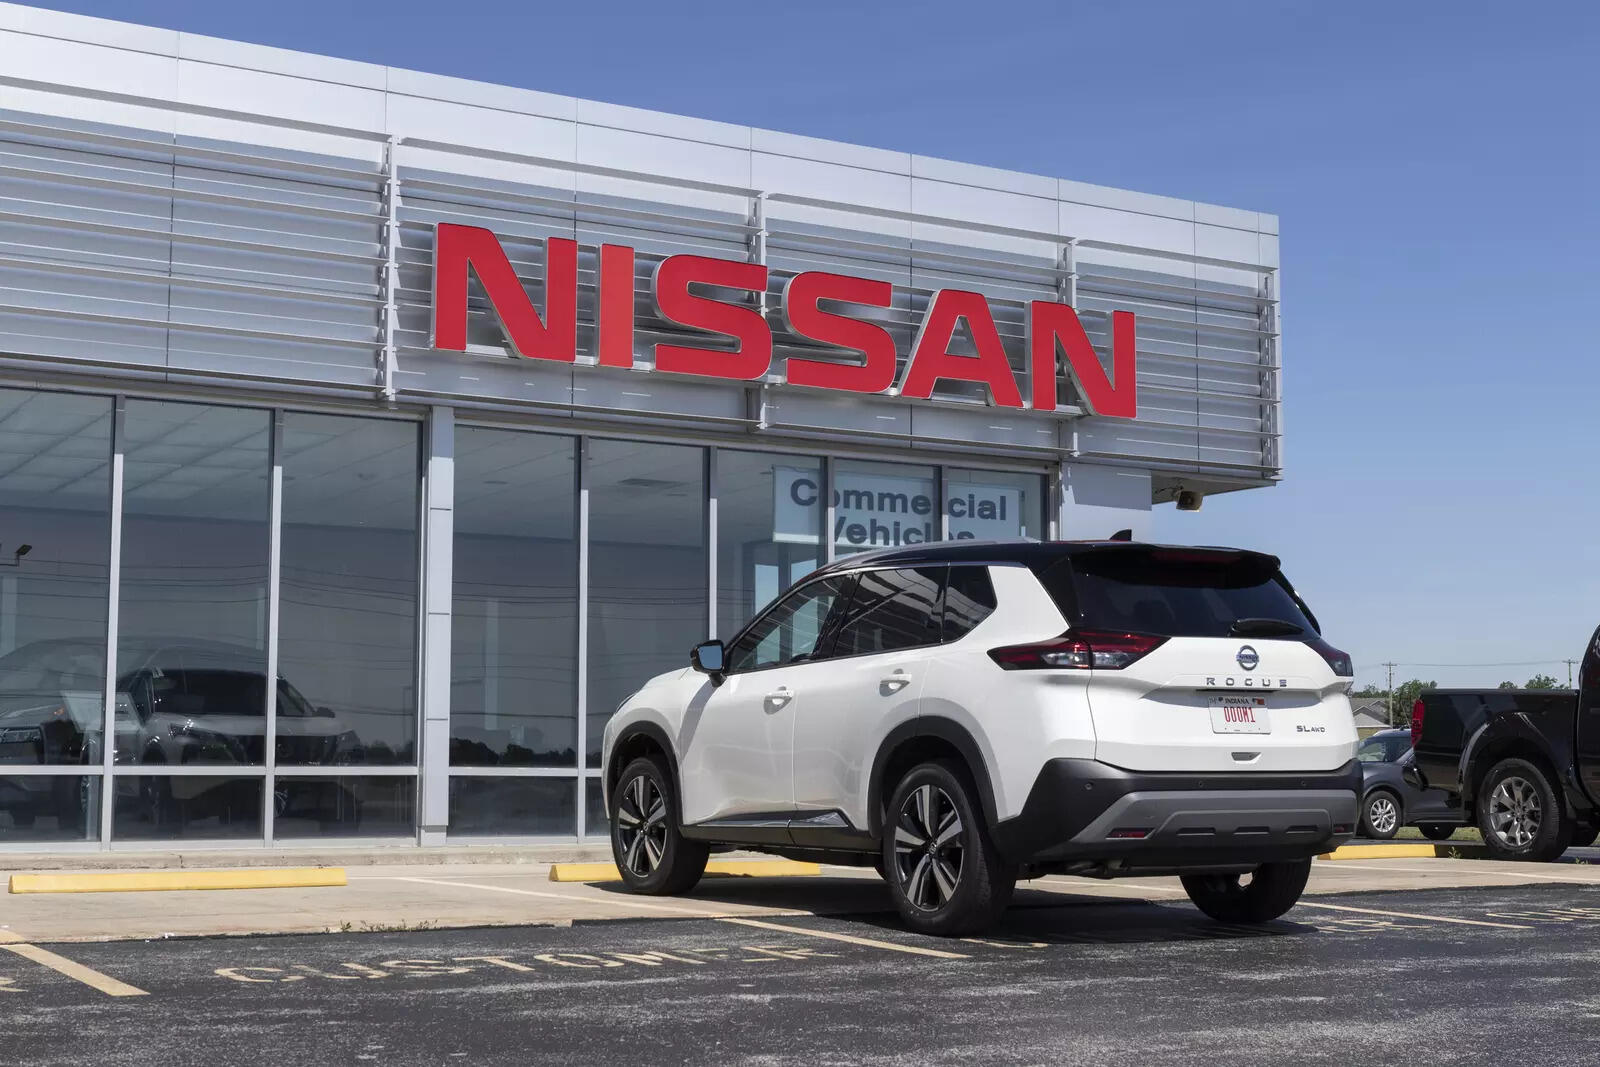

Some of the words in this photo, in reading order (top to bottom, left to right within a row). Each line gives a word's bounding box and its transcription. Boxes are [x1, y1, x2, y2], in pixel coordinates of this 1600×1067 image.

[431, 222, 1138, 419] NISSAN
[790, 477, 1007, 521] Cmmecial
[834, 516, 976, 546] ehicl
[1206, 677, 1287, 688] ROGUE
